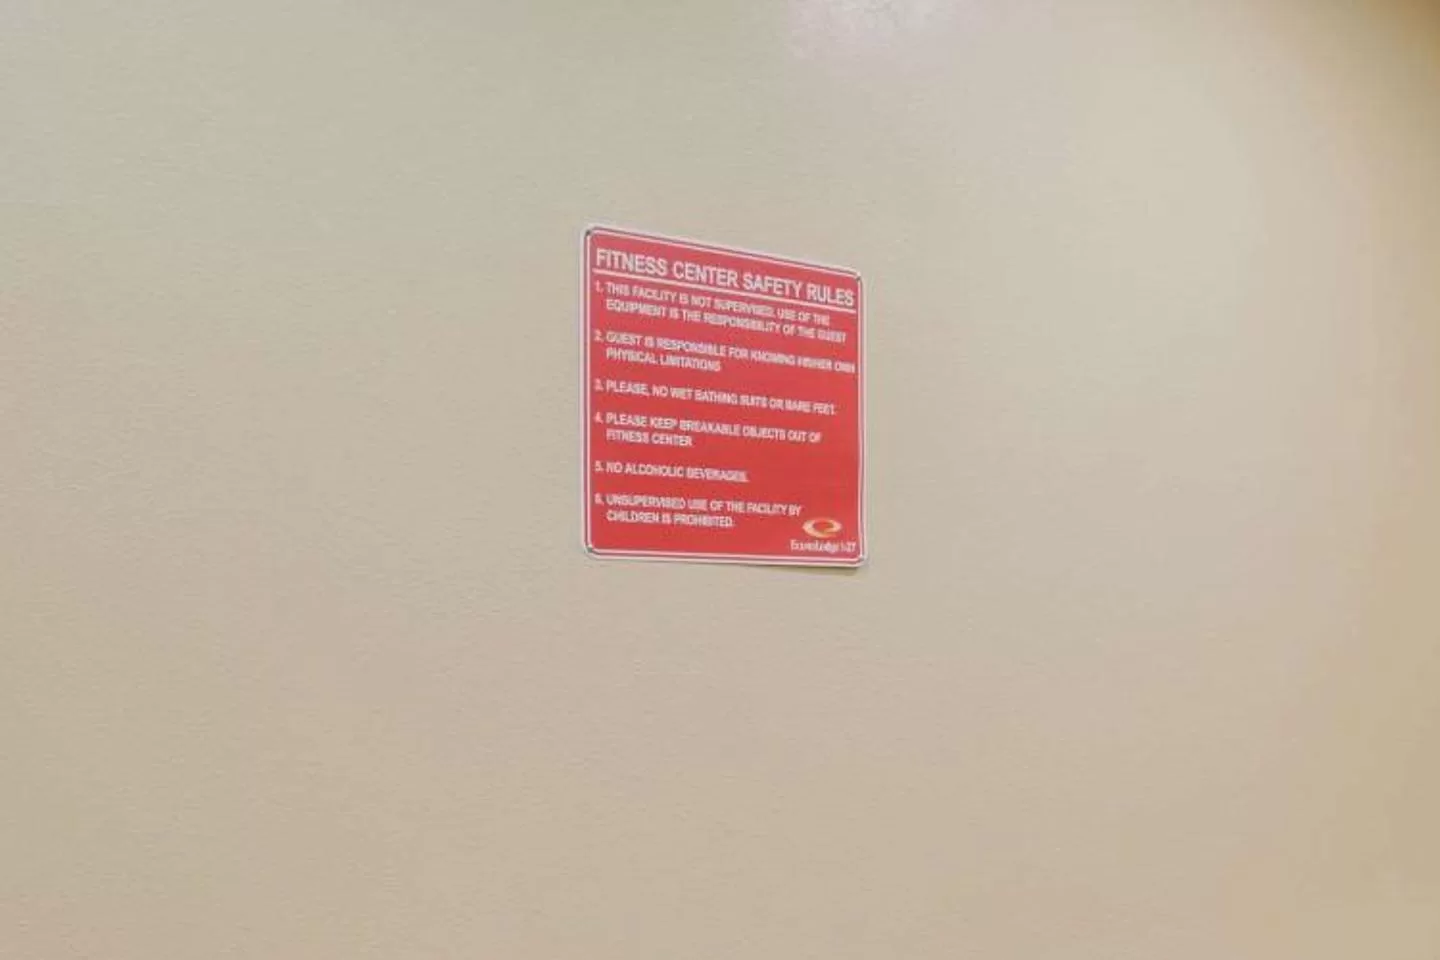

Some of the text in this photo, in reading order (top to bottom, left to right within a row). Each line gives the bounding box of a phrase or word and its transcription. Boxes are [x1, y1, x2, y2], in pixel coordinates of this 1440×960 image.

[596, 248, 855, 306] FITNESS CENTER SAFETY RULES
[605, 282, 630, 297] THIS
[632, 285, 678, 304] FACILITY
[679, 293, 688, 305] IS
[690, 295, 711, 308] NOT
[777, 308, 797, 321] USE
[798, 311, 811, 324] OF
[812, 314, 830, 326] THE
[606, 299, 846, 343] EQUIPMENT IS THE RESPONSIBILITY OF THE GUEST
[606, 331, 643, 346] GUEST
[644, 336, 655, 348] IS
[657, 338, 727, 357] RESPONSIBLE
[728, 347, 749, 359] FOR
[750, 350, 796, 366] KNOWING
[834, 361, 856, 373] OWN
[606, 347, 658, 365] PHYSICAL
[652, 384, 669, 397] NO
[670, 387, 693, 400] WET
[695, 389, 738, 405] BATHING
[739, 394, 768, 408] SUITS
[769, 398, 784, 410] OR
[785, 400, 812, 413] BARE
[605, 412, 648, 427] PLEASE
[650, 417, 678, 429] KEEP
[679, 420, 740, 437] BREAKABLE
[742, 425, 786, 440] OBJECTS
[787, 430, 808, 442] OUT
[809, 432, 822, 443] OF
[606, 428, 650, 444] FITNESS
[595, 461, 604, 473] 5.
[606, 462, 623, 474] NO
[624, 463, 685, 478] ALCOHOLIC
[606, 494, 686, 510] UNSUPERVISED
[687, 499, 708, 511] USE
[710, 500, 725, 512] OF
[726, 501, 746, 513] THE
[747, 502, 787, 517] FACILITY
[788, 505, 802, 517] BY
[606, 510, 660, 523] CHILDREN
[662, 513, 672, 524] IS
